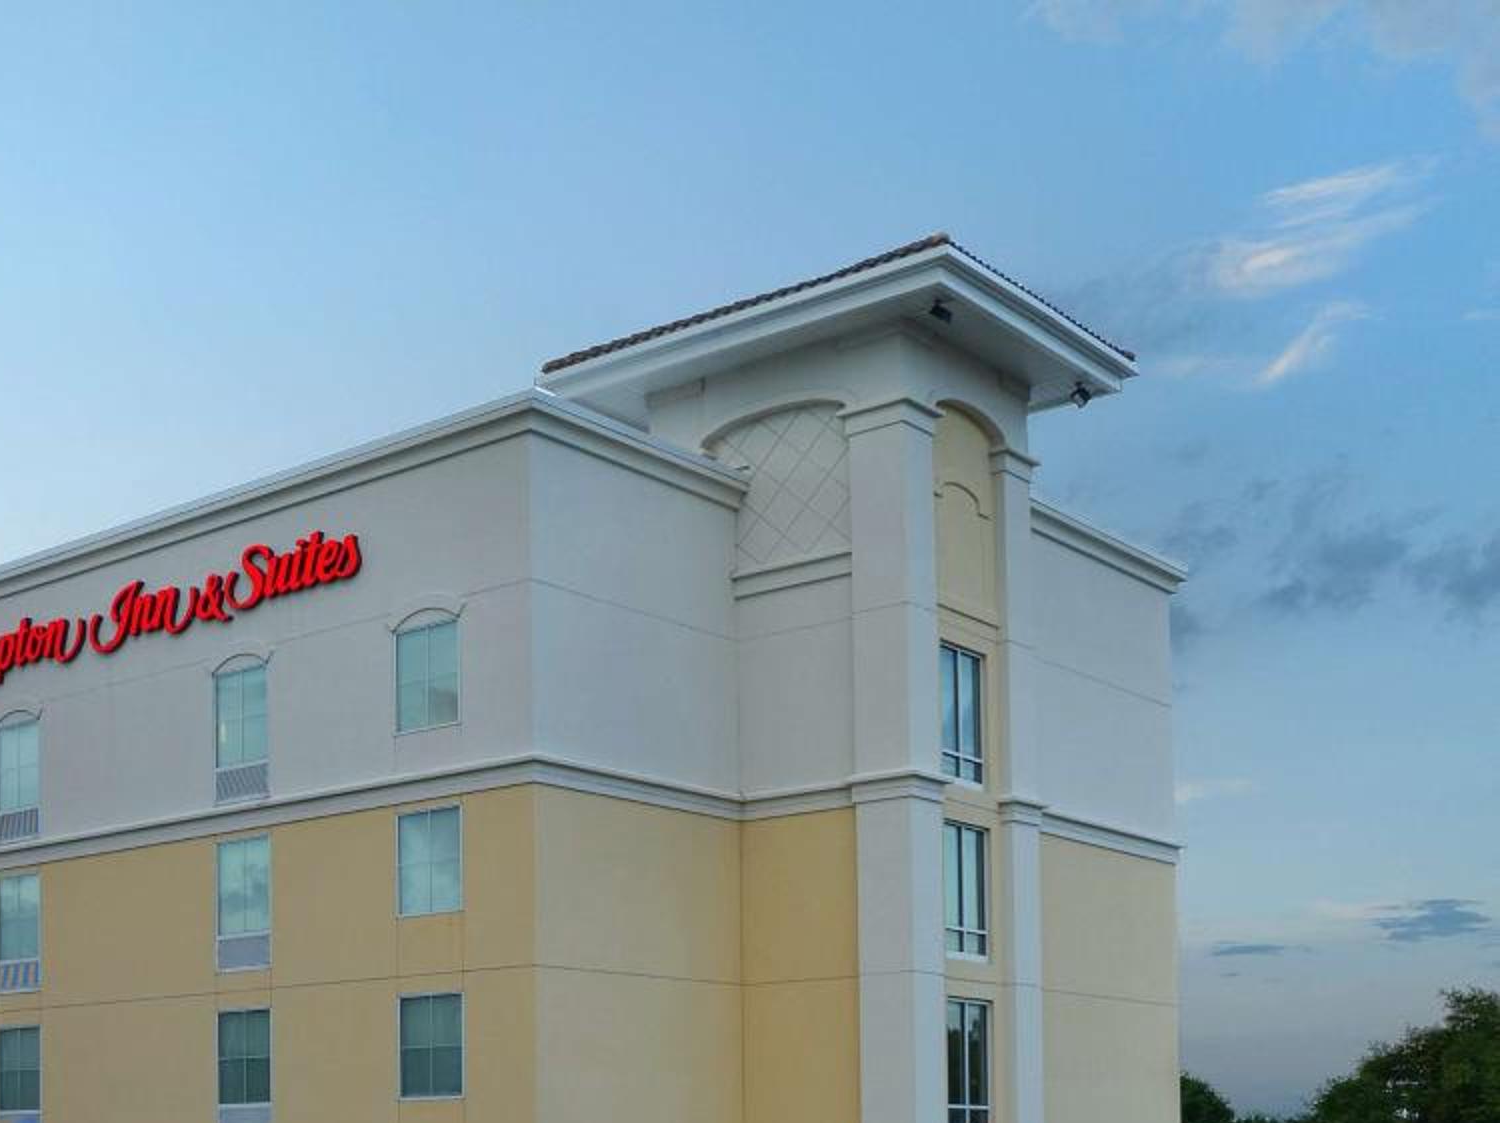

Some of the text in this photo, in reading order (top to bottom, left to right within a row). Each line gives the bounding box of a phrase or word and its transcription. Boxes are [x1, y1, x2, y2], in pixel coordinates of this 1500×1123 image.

[89, 580, 200, 655] Inn
[195, 574, 233, 622] &
[226, 530, 363, 610] Suites
